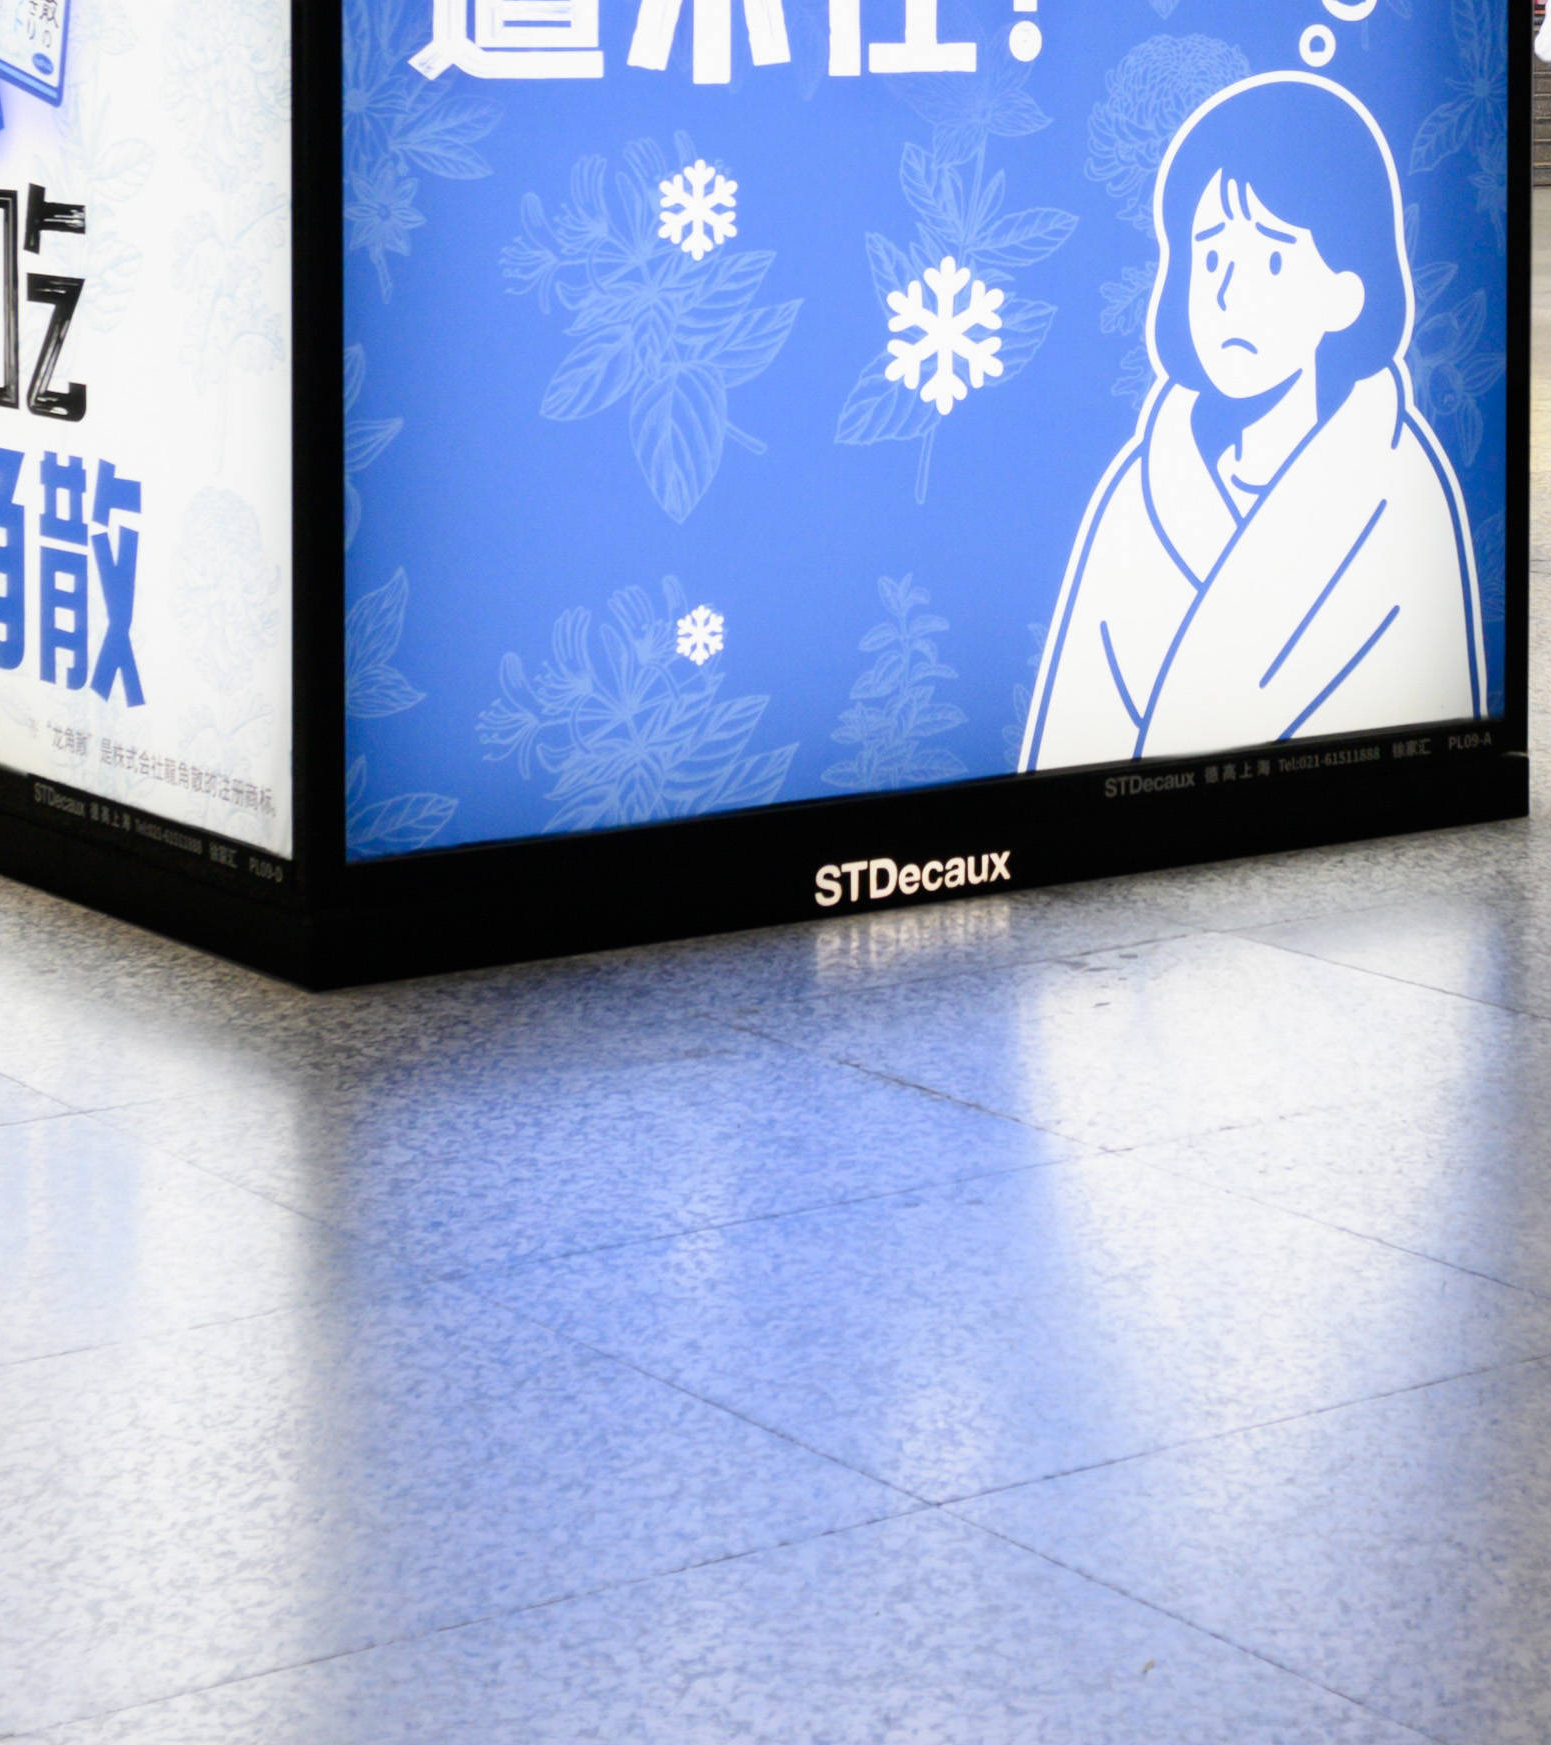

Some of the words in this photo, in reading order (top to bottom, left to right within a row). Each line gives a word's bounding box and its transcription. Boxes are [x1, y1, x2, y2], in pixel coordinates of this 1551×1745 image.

[1104, 771, 1196, 798] STDecaux
[1448, 731, 1492, 751] PL09-A
[814, 850, 1011, 908] STDecaux
